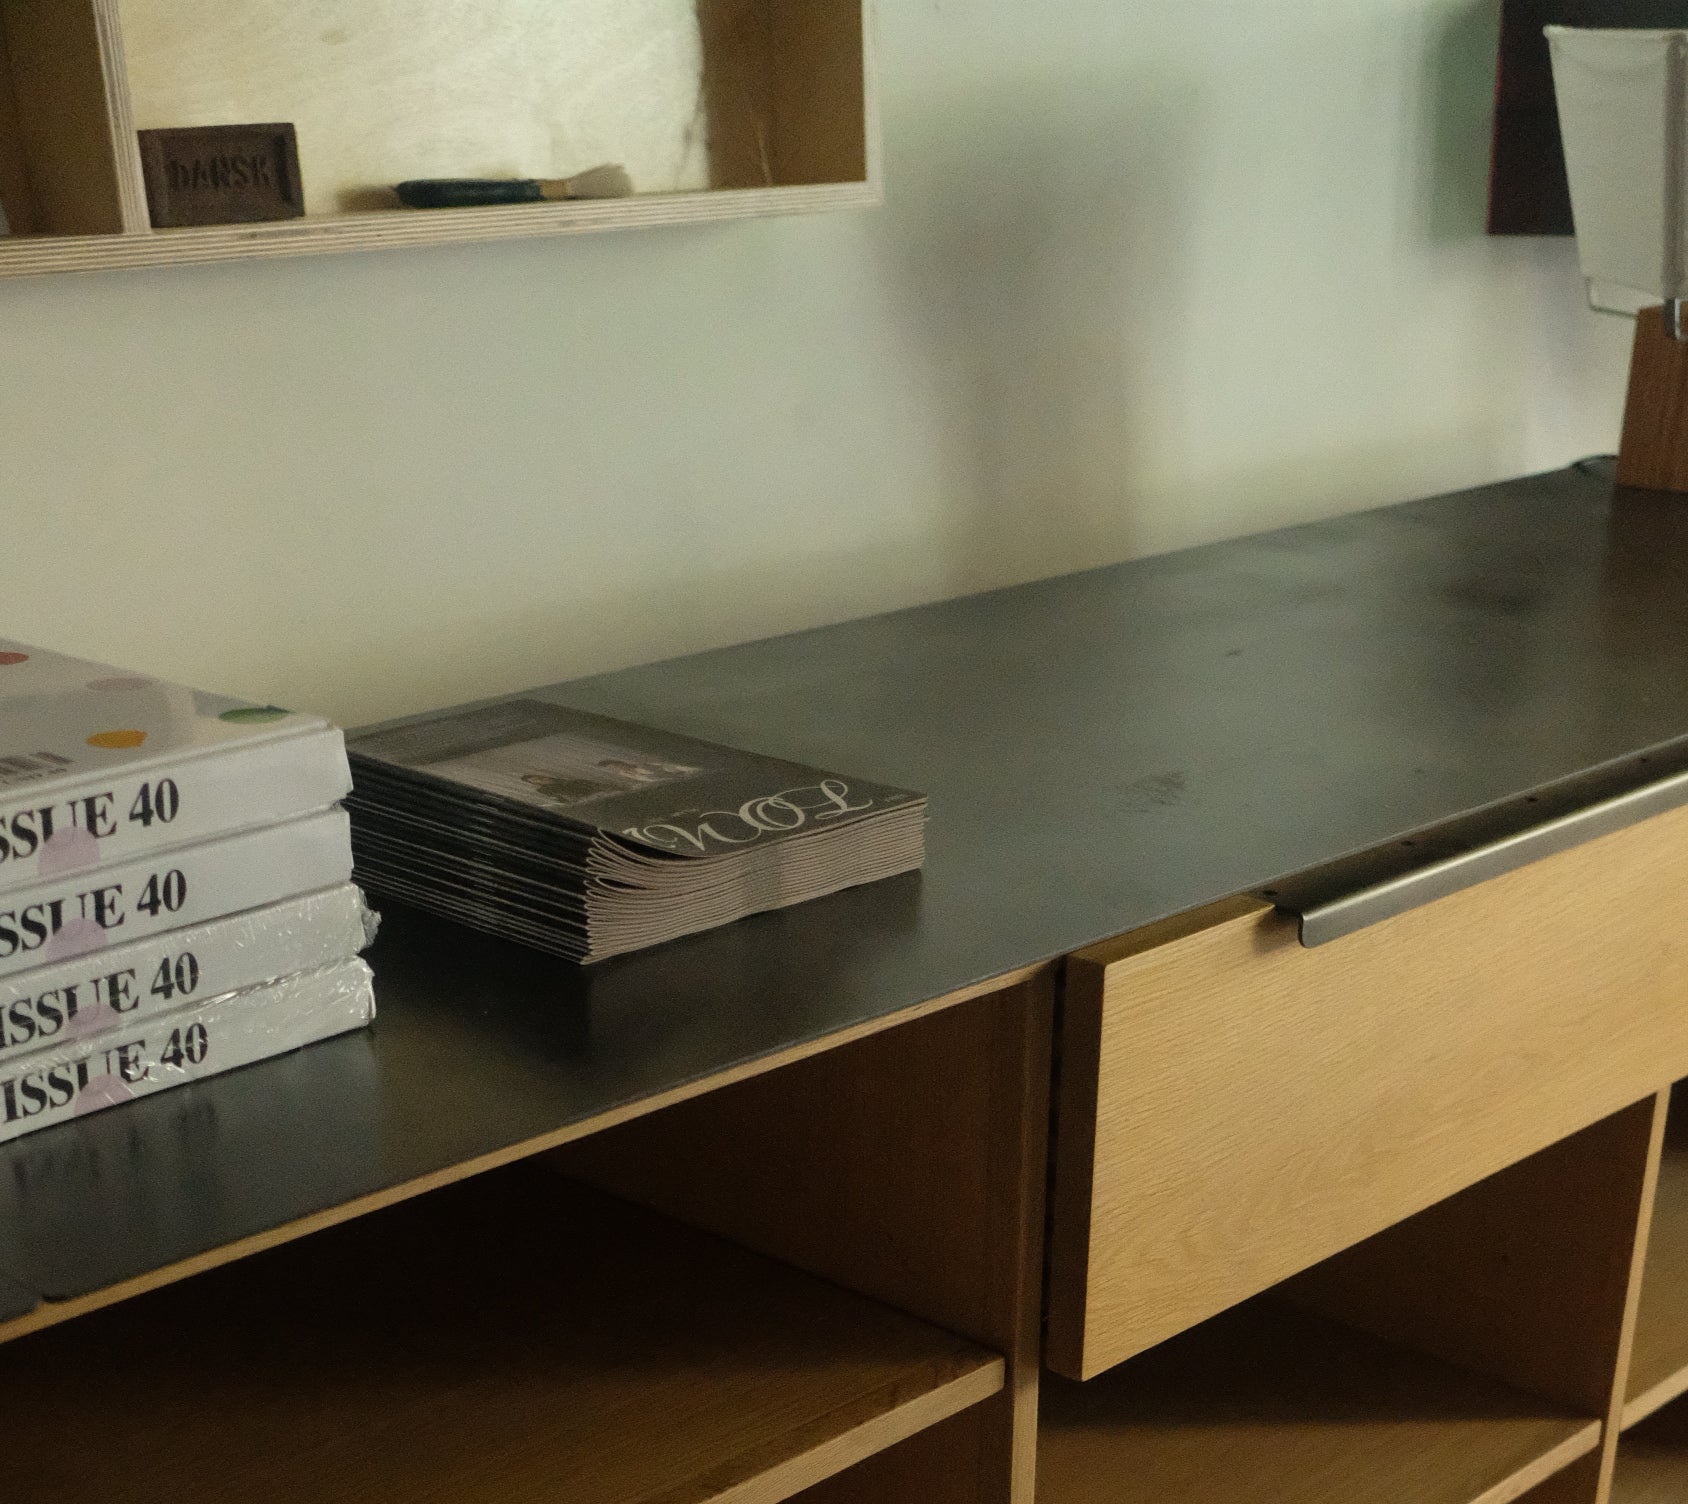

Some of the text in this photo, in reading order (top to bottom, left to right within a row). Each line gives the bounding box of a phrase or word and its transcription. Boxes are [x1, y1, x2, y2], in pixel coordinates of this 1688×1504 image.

[129, 778, 179, 827] 40
[137, 869, 187, 917] 40
[150, 952, 199, 1000] 40
[1, 1022, 208, 1124] ISSUE 40
